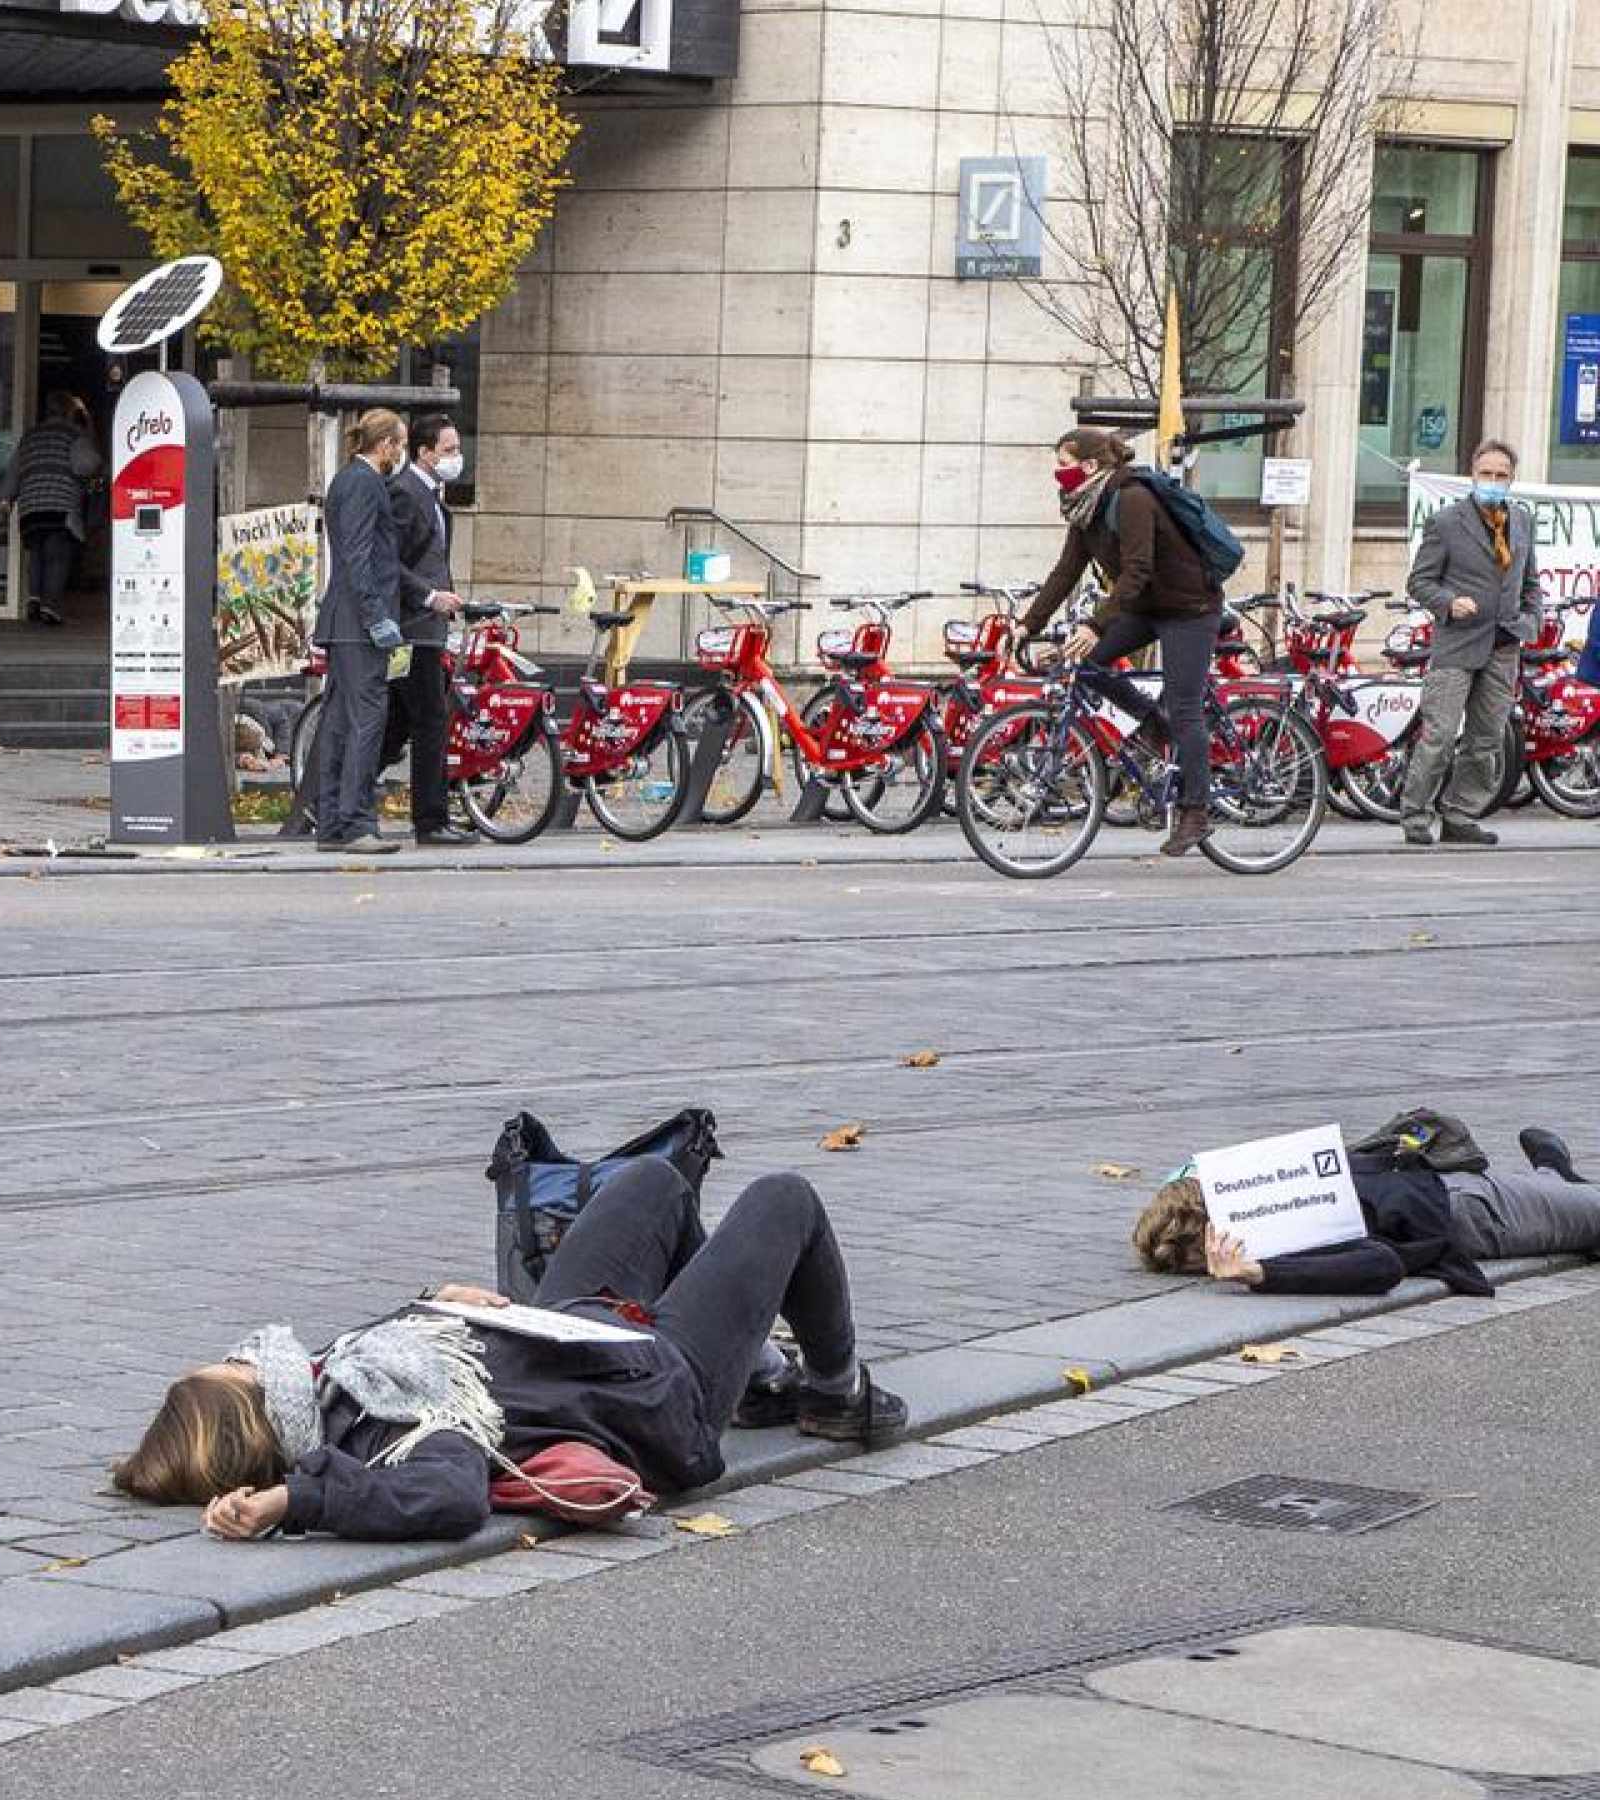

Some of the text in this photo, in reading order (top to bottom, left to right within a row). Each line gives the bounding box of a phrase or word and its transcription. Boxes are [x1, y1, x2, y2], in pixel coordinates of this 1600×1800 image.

[837, 218, 851, 249] 3
[1214, 1164, 1310, 1195] Deutsche Bank
